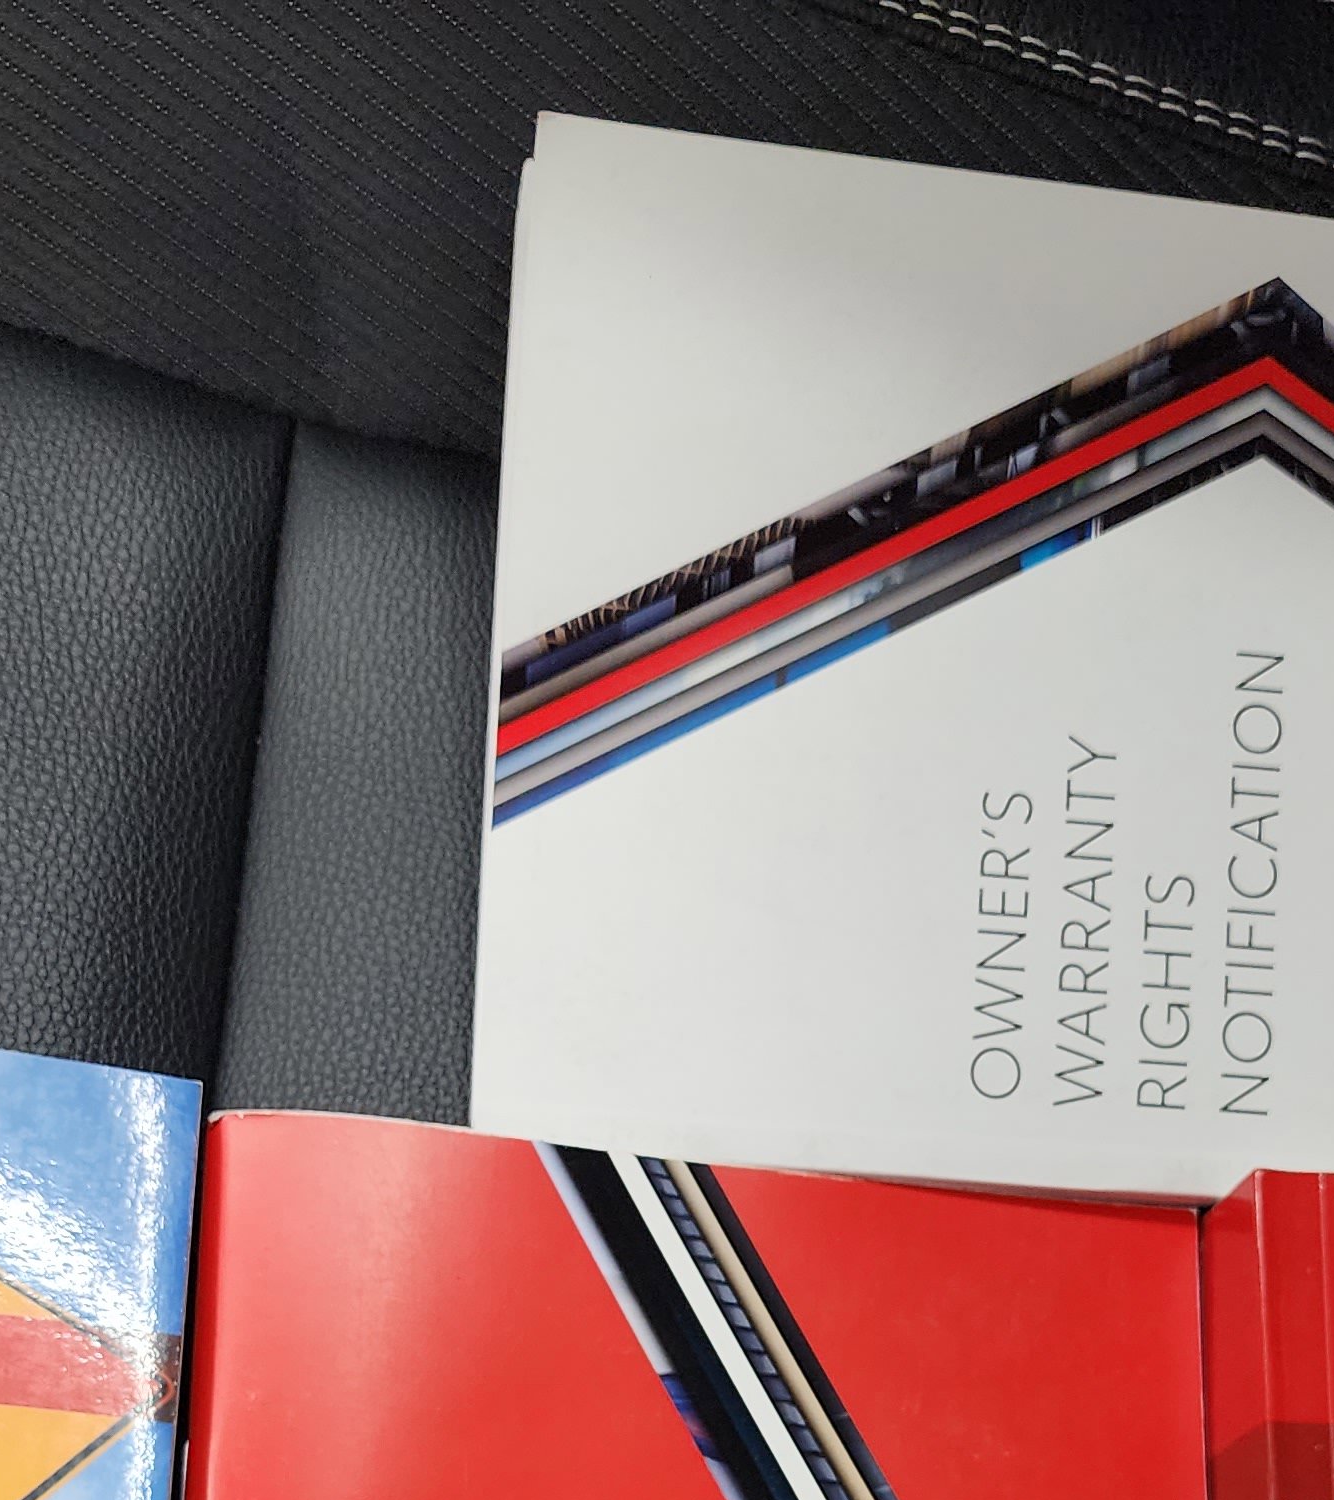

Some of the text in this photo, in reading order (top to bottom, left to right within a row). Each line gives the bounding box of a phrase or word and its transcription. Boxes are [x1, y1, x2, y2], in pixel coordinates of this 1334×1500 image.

[969, 791, 1034, 1099] OWNER'S
[1053, 735, 1117, 1107] WARRANTY
[1136, 874, 1195, 1111] RIGHTS
[1219, 651, 1285, 1116] NOTIFICATION
